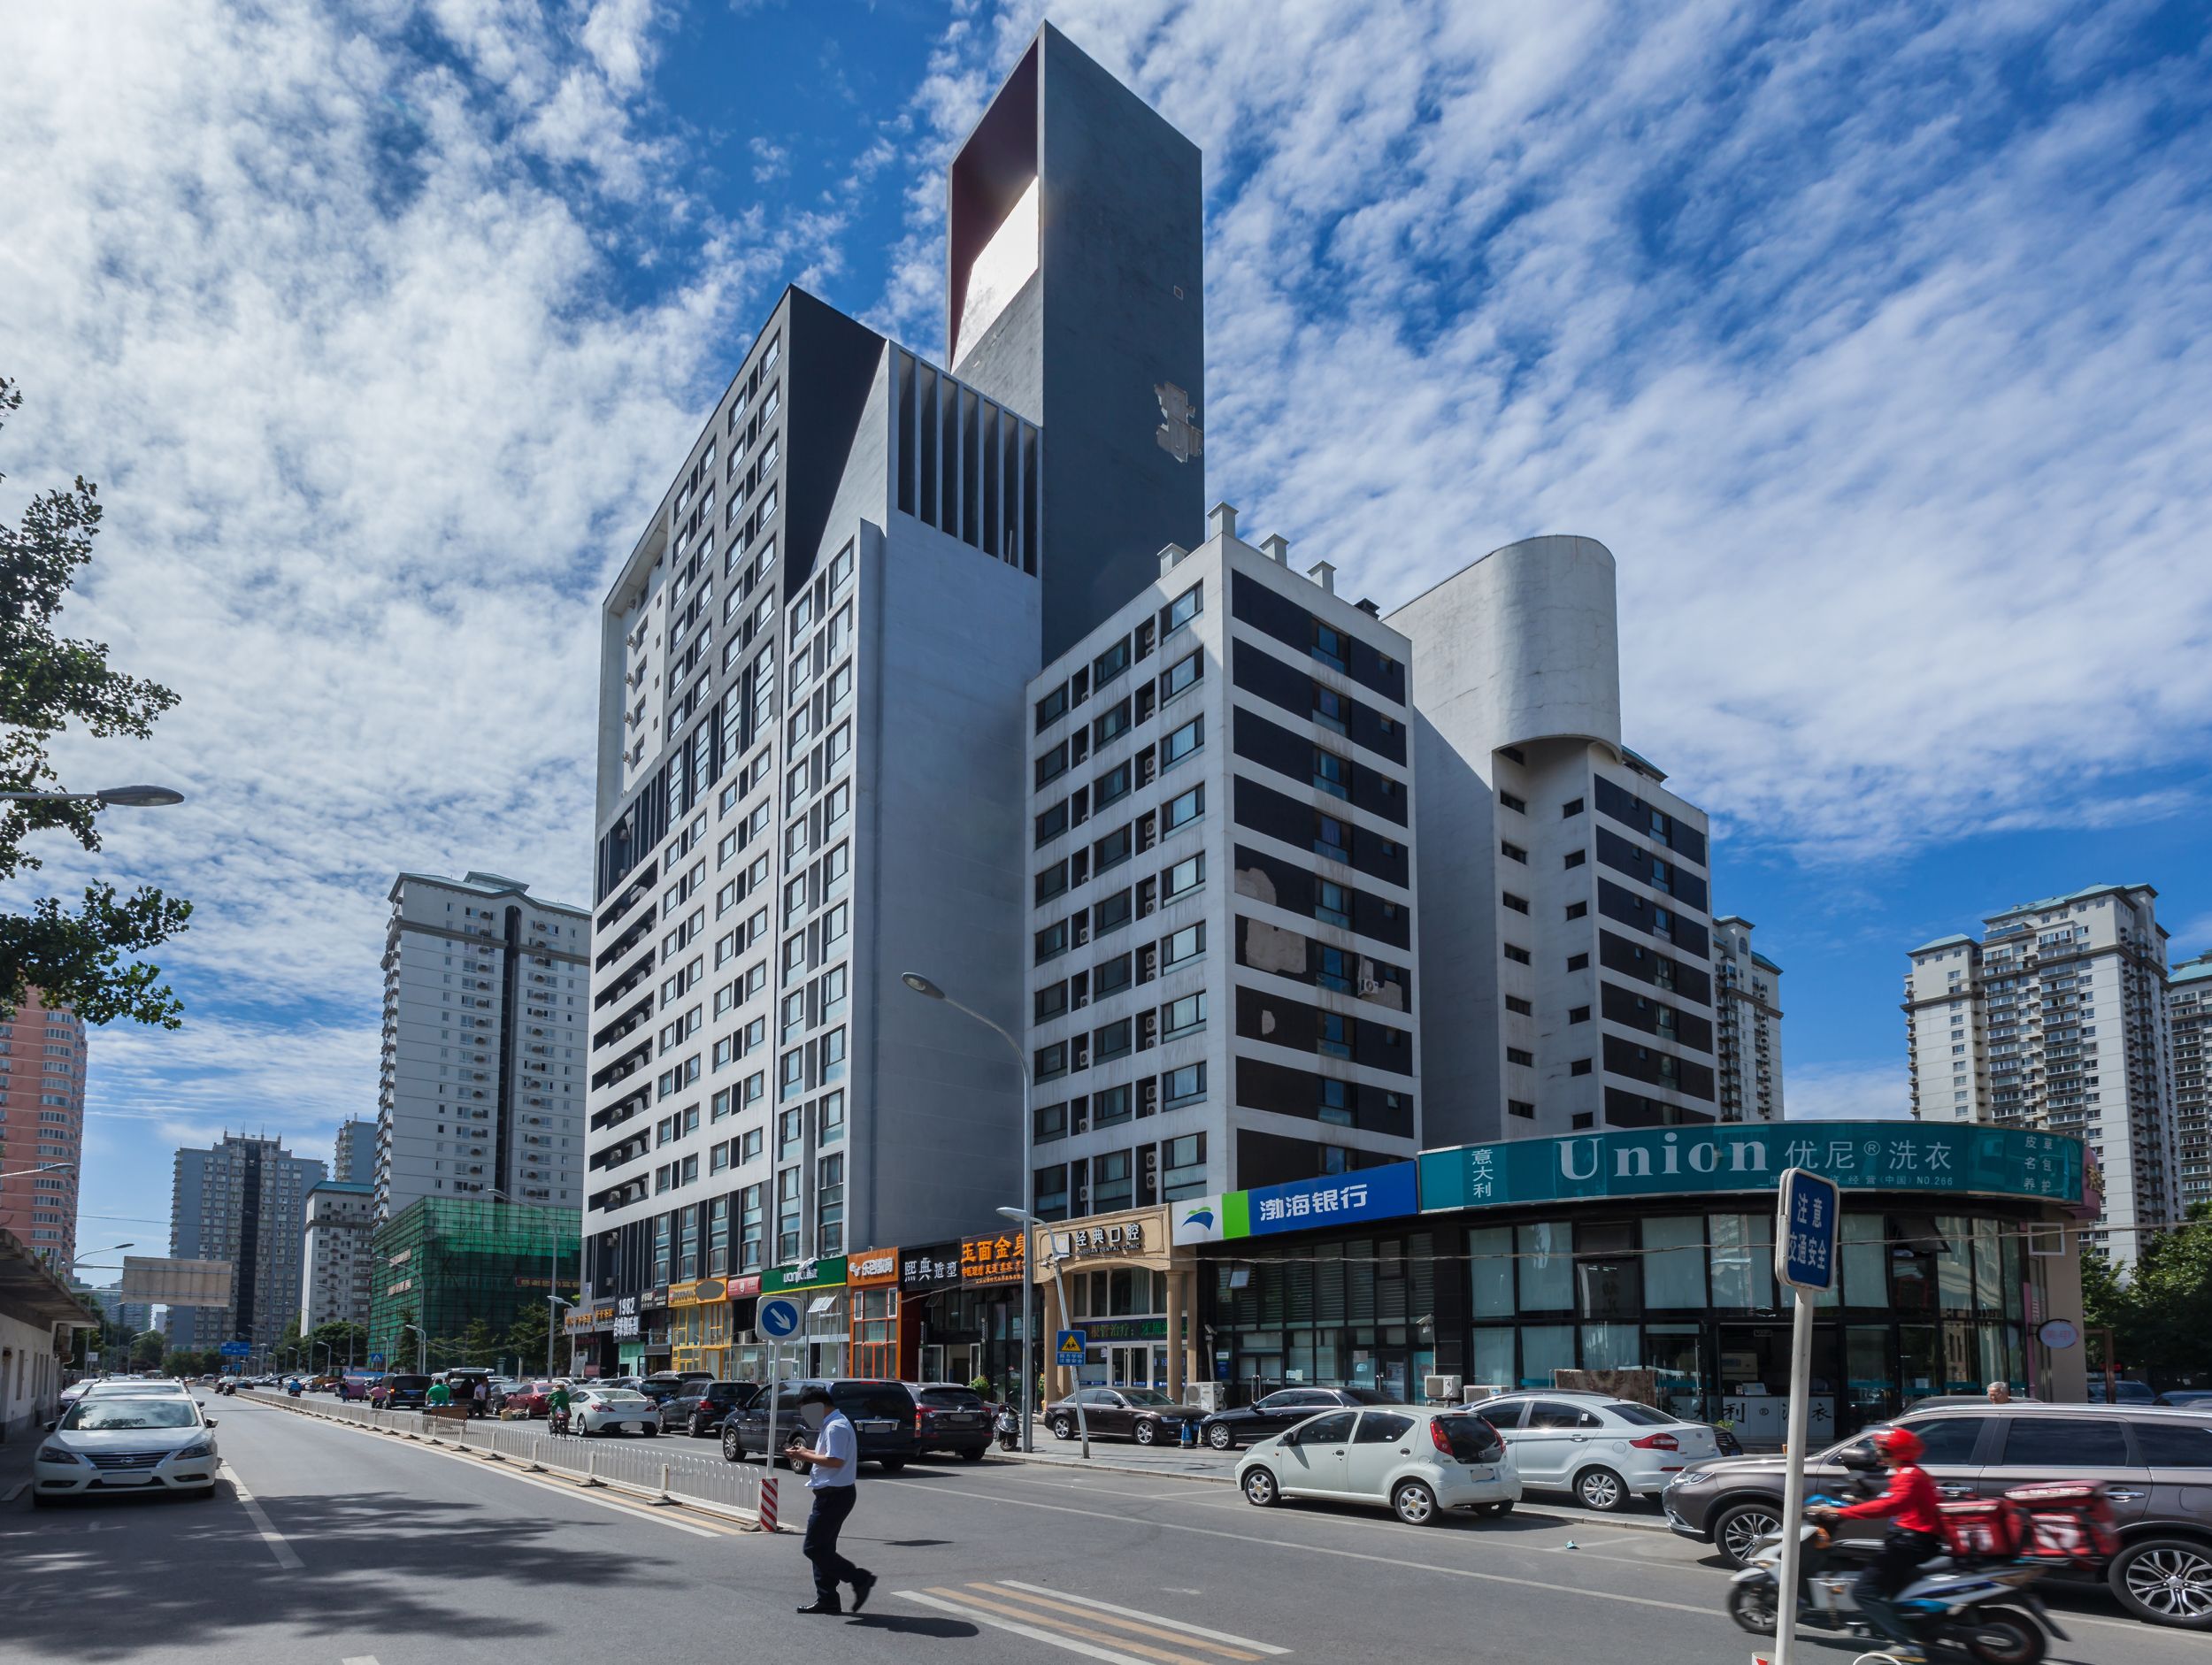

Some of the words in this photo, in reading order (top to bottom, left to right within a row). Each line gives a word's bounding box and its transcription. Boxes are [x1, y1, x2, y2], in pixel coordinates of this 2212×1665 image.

[1471, 1148, 1494, 1198] 意大利
[1554, 1132, 1769, 1180] Union
[1260, 1183, 1368, 1222] 渤海银行
[1797, 1193, 1823, 1228] 注意
[1076, 1224, 1140, 1247] 经典口腔
[1787, 1231, 1826, 1270] 交通安全
[904, 1257, 958, 1282] 熙典造型
[618, 1297, 636, 1316] 1982
